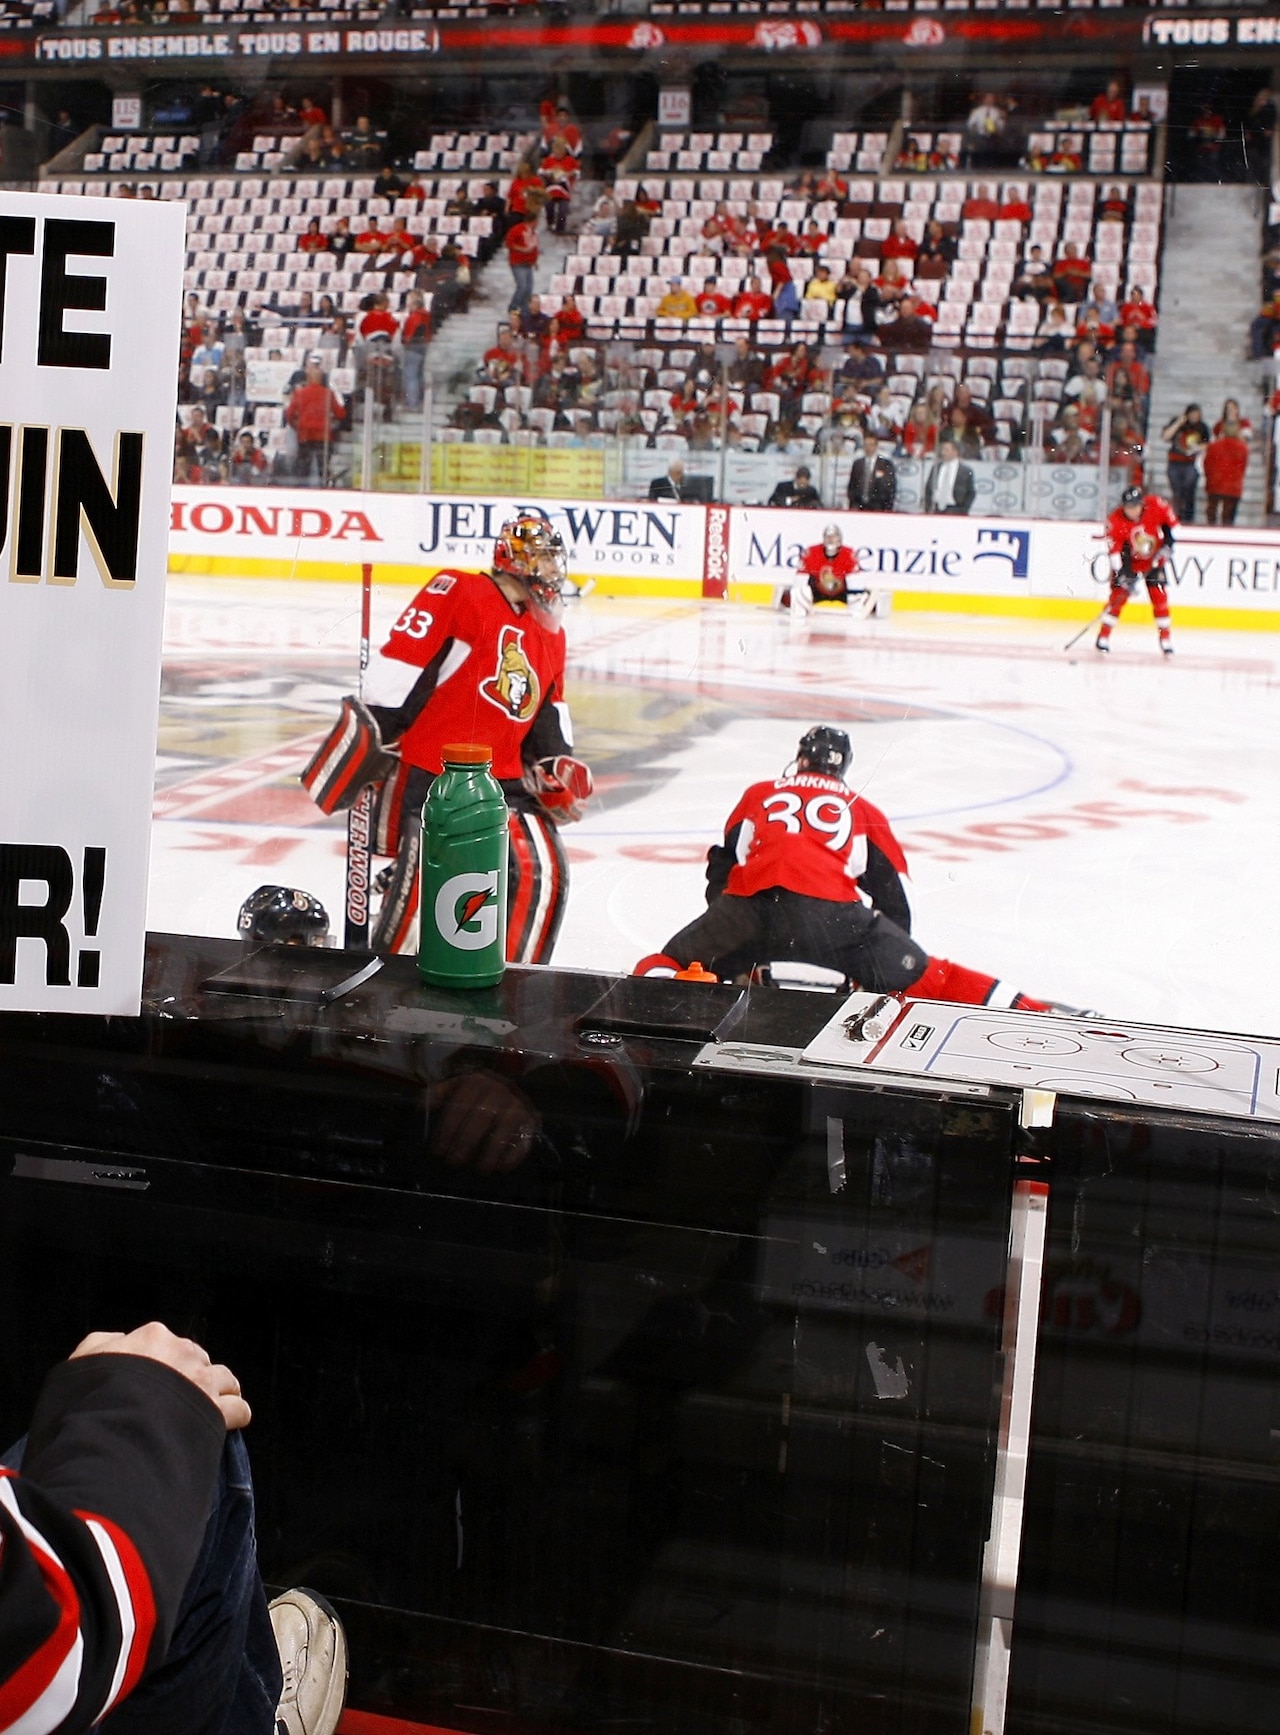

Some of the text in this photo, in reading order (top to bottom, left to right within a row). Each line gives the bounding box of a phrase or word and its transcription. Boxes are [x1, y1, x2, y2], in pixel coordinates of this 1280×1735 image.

[42, 37, 102, 60] TOUS
[238, 32, 301, 54] TOUS
[308, 31, 340, 53] EN
[1152, 18, 1229, 44] TOUS
[595, 550, 676, 566] DOORS
[707, 507, 727, 580] Reebok
[745, 530, 962, 577] Maenzie
[1228, 557, 1280, 592] RE
[393, 607, 434, 639] 33
[762, 791, 853, 852] 39
[434, 869, 499, 951] G
